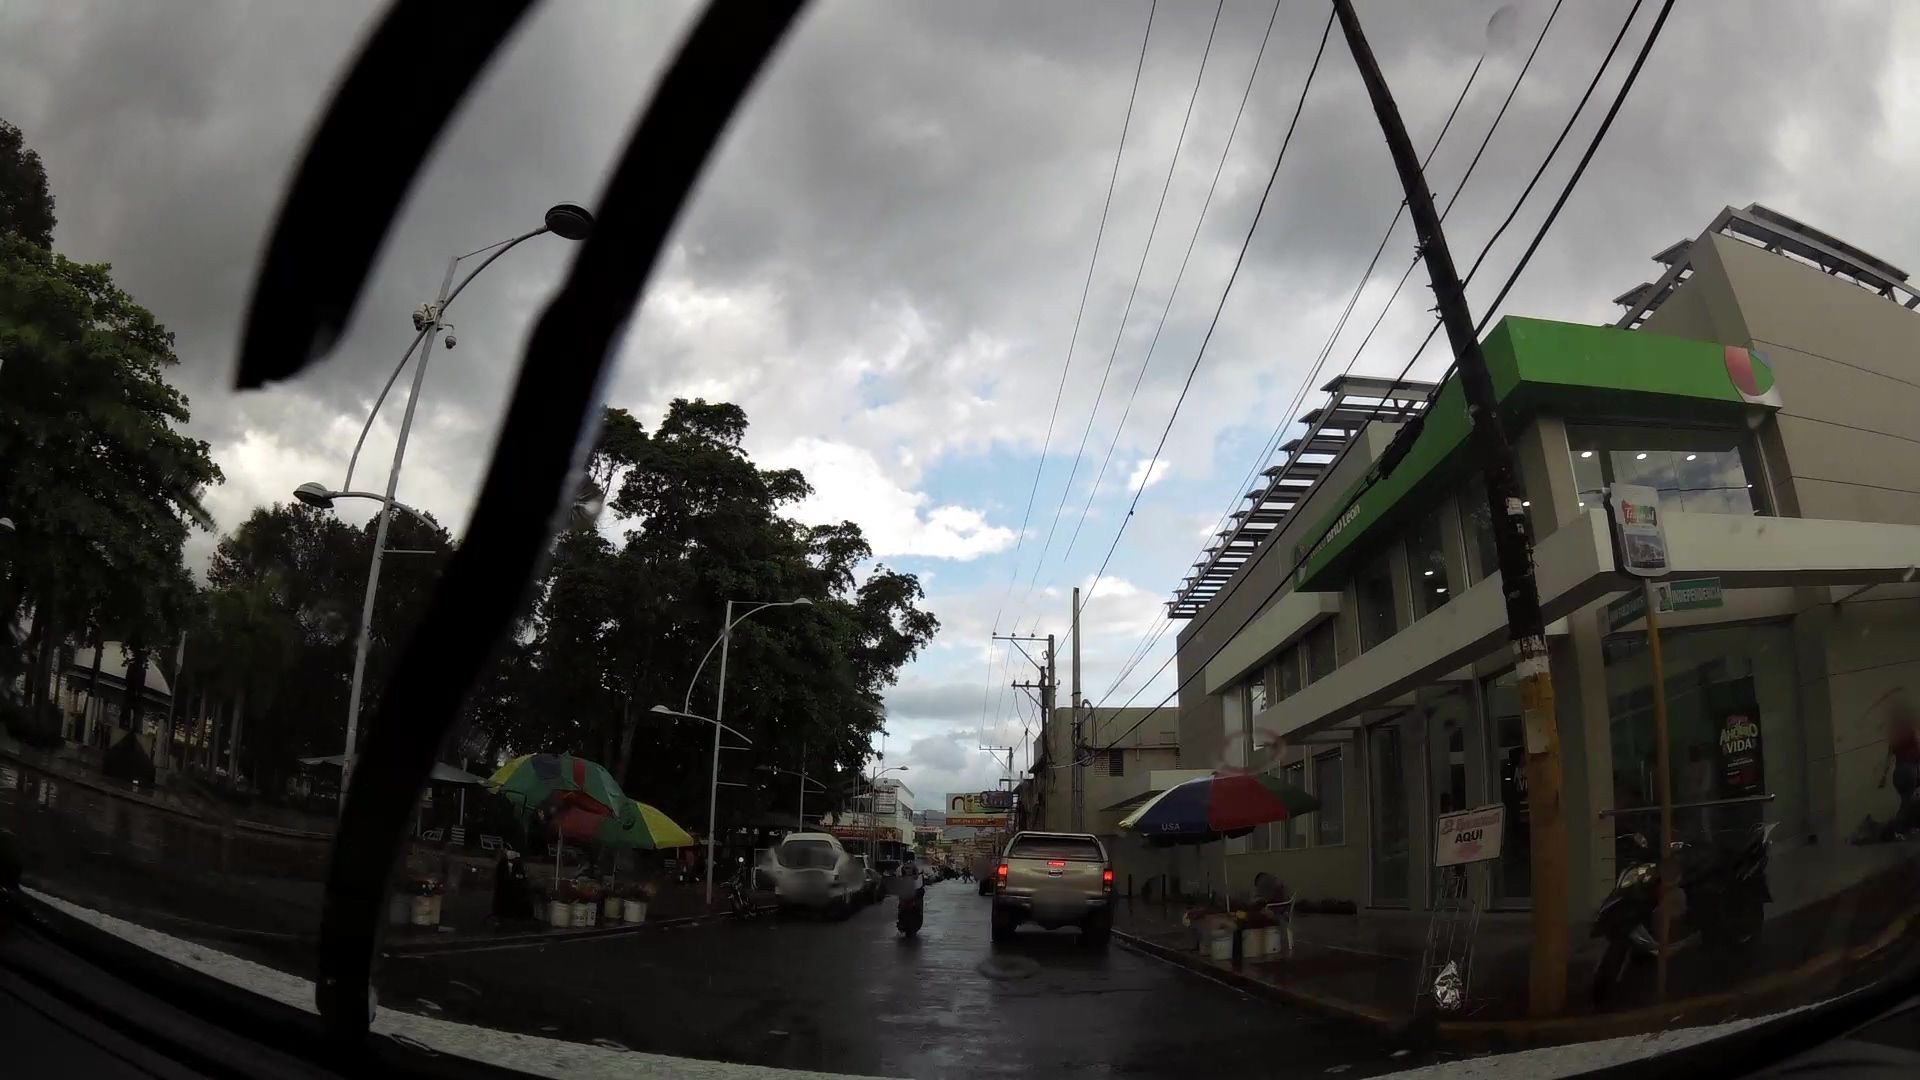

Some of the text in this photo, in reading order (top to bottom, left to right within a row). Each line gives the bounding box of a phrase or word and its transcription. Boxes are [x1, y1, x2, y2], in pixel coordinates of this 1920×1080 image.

[1726, 738, 1752, 753] VIDA
[1161, 823, 1181, 832] USA
[1454, 829, 1483, 844] AQUI
